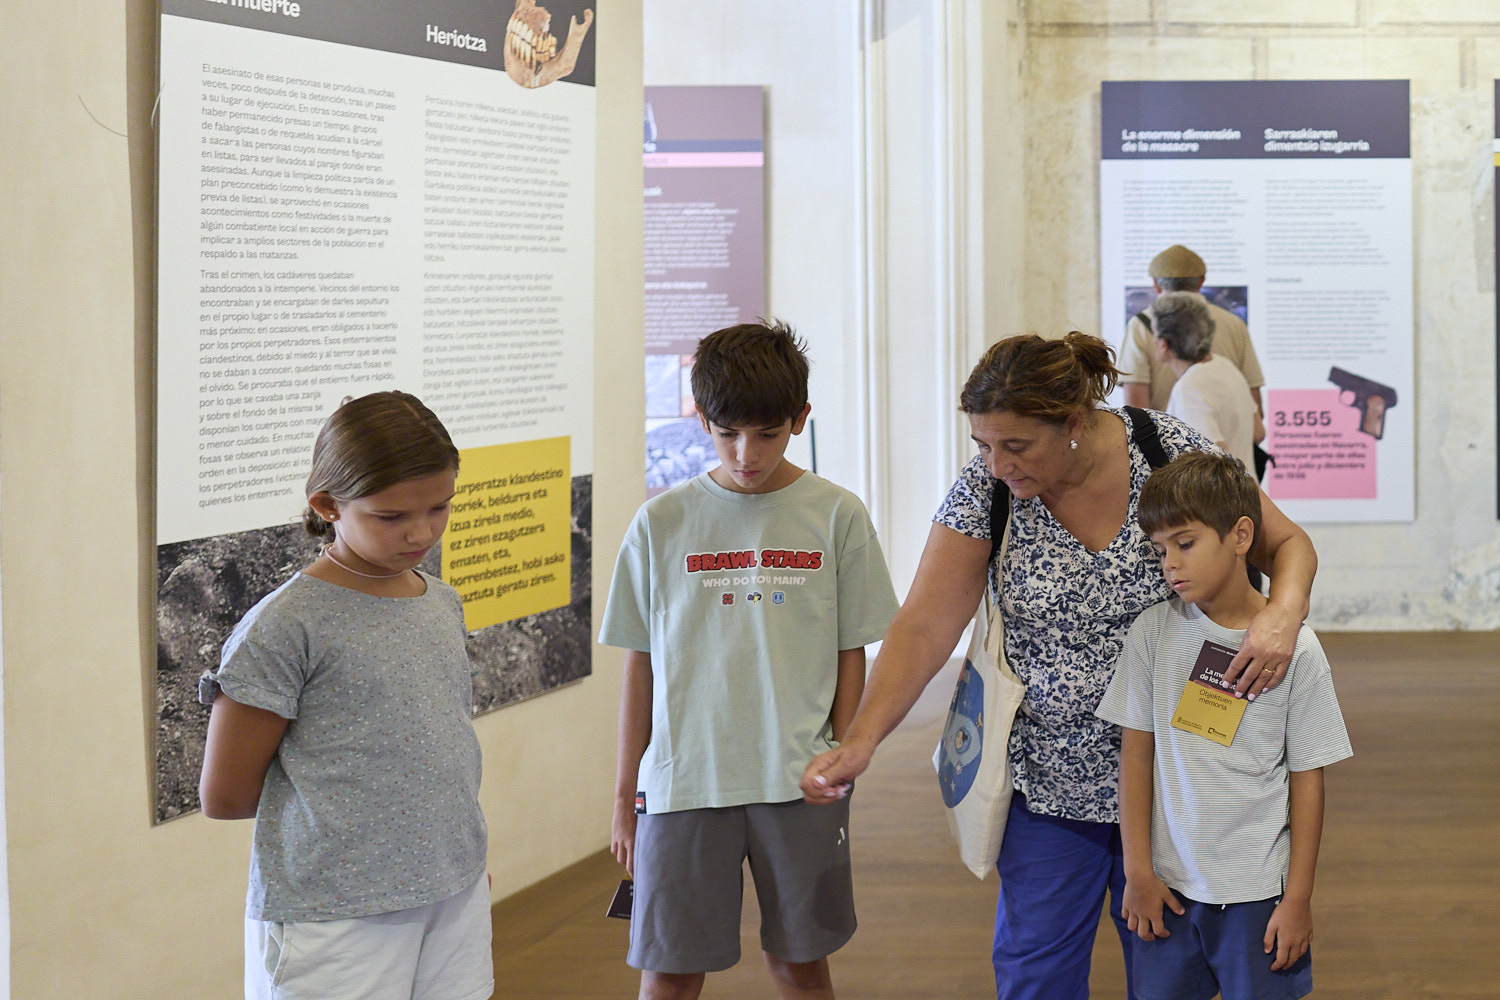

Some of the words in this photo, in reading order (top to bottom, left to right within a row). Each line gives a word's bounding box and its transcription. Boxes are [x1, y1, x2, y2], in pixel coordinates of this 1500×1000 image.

[426, 24, 487, 52] Heriotza
[202, 64, 210, 73] El
[212, 65, 252, 79] asesinato
[254, 71, 264, 80] de
[266, 74, 284, 83] esas
[286, 76, 321, 89] personas
[202, 80, 229, 91] veces,
[231, 83, 252, 94] poco
[254, 84, 287, 99] después
[289, 91, 298, 99] de
[200, 250, 237, 260] respaldo
[247, 250, 257, 258] las
[260, 251, 298, 260] matanzas.
[1274, 411, 1331, 426] 3.555
[455, 478, 507, 495] urperatze
[510, 468, 563, 484] klandestino
[451, 498, 486, 513] horiek,
[488, 492, 530, 507] beldurra
[533, 489, 547, 498] eta
[450, 520, 470, 532] izua
[473, 513, 501, 528] zirela
[503, 507, 535, 521] medio,
[450, 540, 462, 550] ez
[464, 534, 490, 548] ziren
[492, 523, 544, 542] ezagutzera
[450, 553, 490, 569] ematen,
[493, 548, 511, 560] eta,
[523, 556, 542, 570] hobi
[544, 553, 565, 566] asko
[686, 550, 758, 573] BRAWL
[760, 550, 823, 570] STARS
[461, 587, 494, 602] aztuta
[496, 579, 528, 598] geratu
[530, 573, 555, 586] ziren.
[703, 577, 730, 588] WHO
[733, 577, 748, 586] DO
[751, 575, 771, 584] YOU
[773, 577, 806, 585] MAIN?
[1199, 697, 1227, 710] memoria
[1200, 689, 1232, 704] Objektuen
